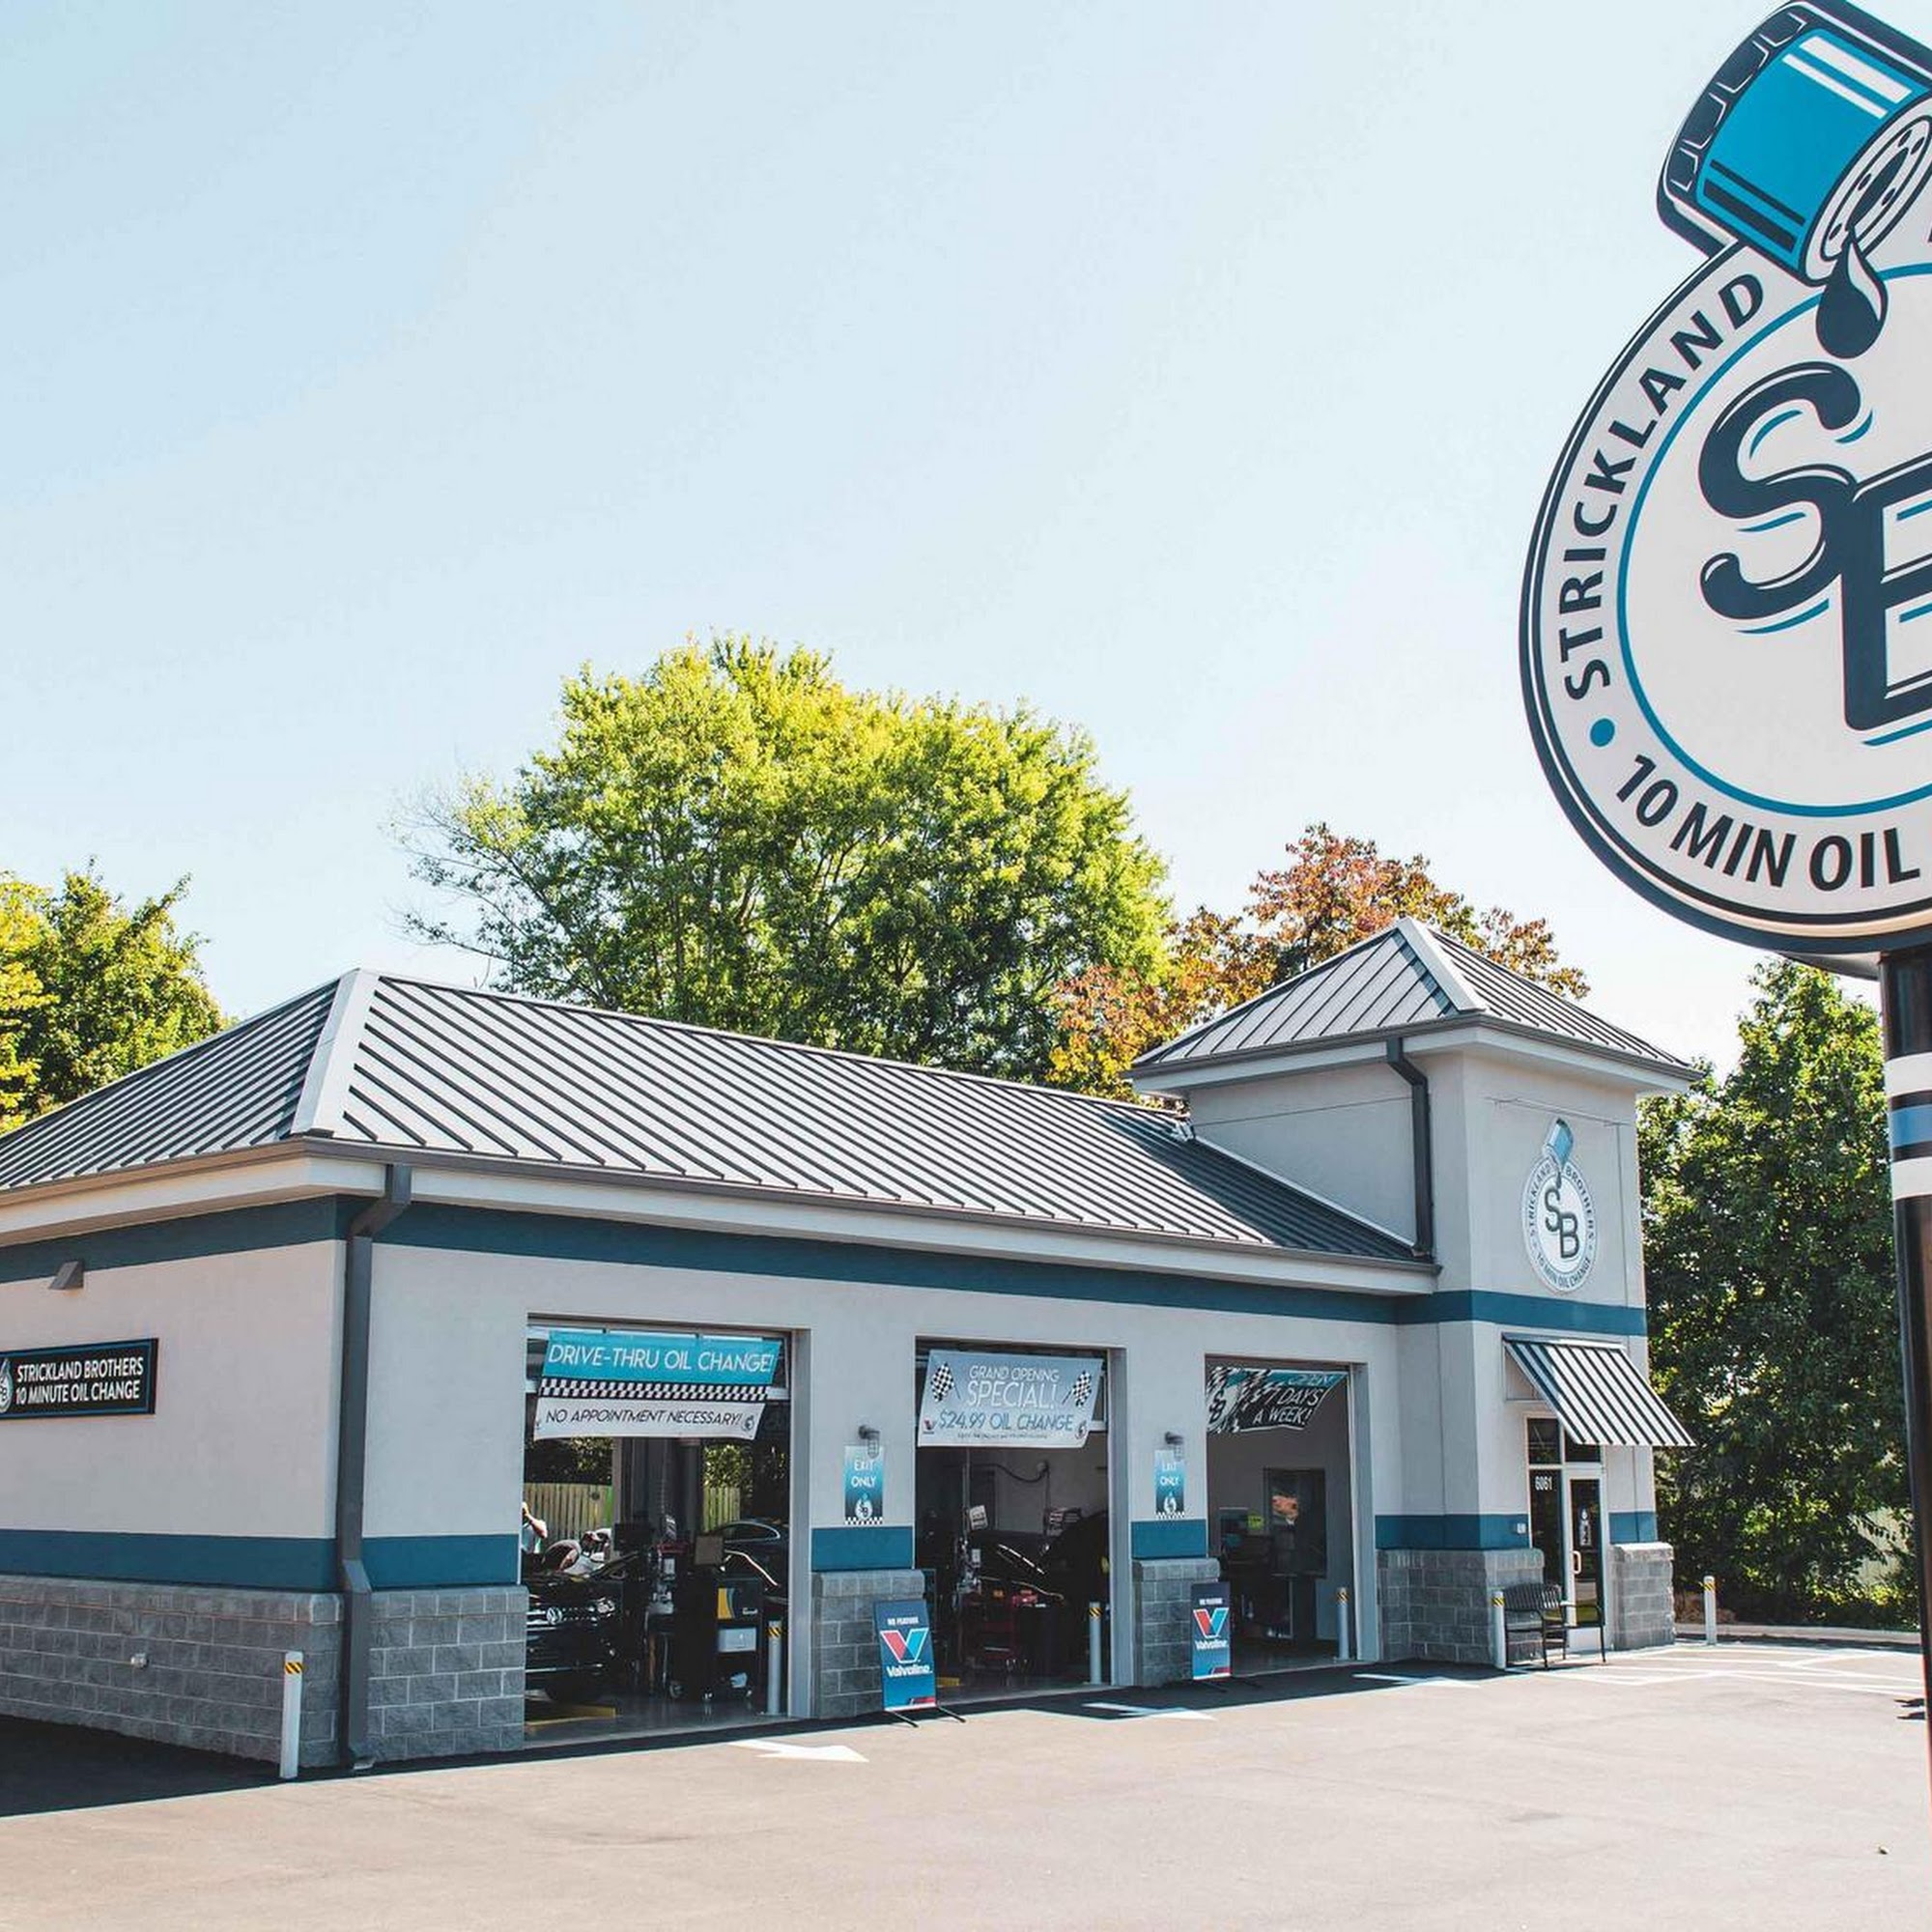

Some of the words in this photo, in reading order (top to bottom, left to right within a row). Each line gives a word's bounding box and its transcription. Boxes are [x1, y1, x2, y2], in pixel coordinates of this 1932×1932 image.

[1558, 273, 1764, 701] STRICKLAND
[1614, 753, 1679, 828] 10
[1669, 802, 1797, 889] MIN
[1809, 827, 1920, 892] OIL
[1545, 1187, 1580, 1259] SB
[16, 1360, 82, 1382] STRICKLAND
[83, 1356, 144, 1378] BROTHERS
[548, 1344, 660, 1369] DRIVE-THRU
[665, 1350, 692, 1371] OIL
[697, 1351, 774, 1373] CHANGE!
[969, 1365, 1009, 1380] GRAND
[1011, 1368, 1061, 1382] OPENING
[15, 1386, 27, 1405] 10
[27, 1384, 69, 1405] MINUTE
[71, 1382, 89, 1402] OIL
[91, 1379, 140, 1400] CHANGE
[967, 1380, 1057, 1409] SPECIAL!
[1276, 1387, 1323, 1406] DAYS
[546, 1408, 568, 1424] NO
[570, 1409, 666, 1424] APPOINTMENT
[667, 1410, 743, 1425] NECESSARY!
[939, 1409, 987, 1430] $24.99
[989, 1411, 1012, 1431] OIL
[1017, 1413, 1074, 1431] CHANGE
[1253, 1408, 1264, 1424] A
[851, 1475, 876, 1488] ONLY
[886, 1663, 930, 1678] Valvoline
